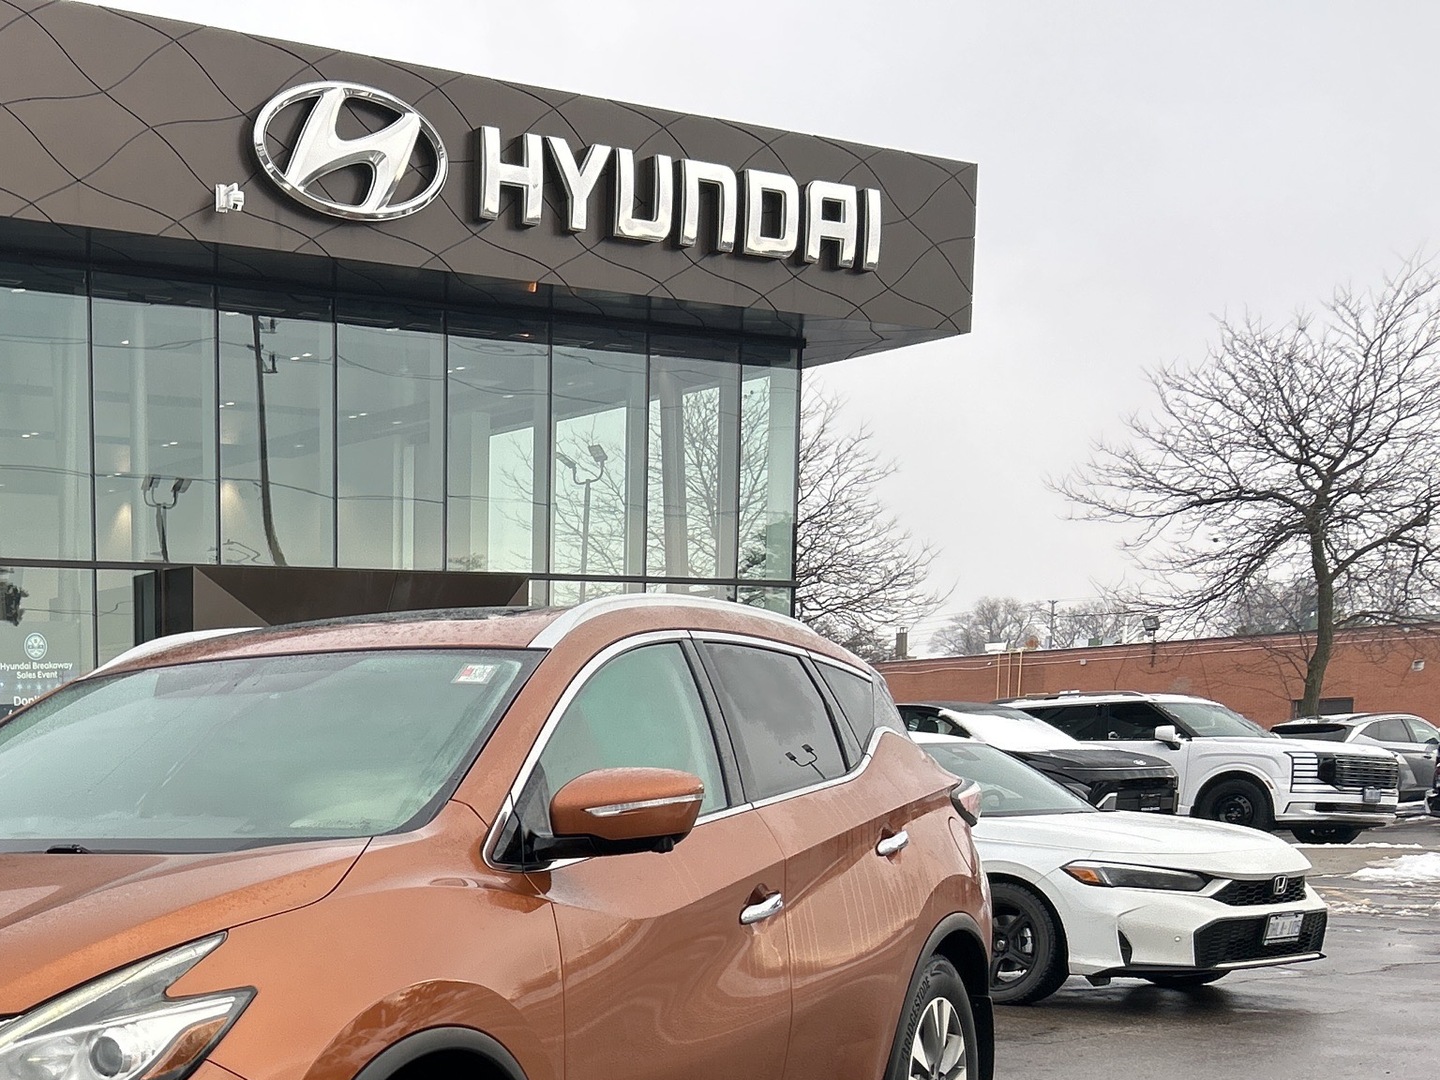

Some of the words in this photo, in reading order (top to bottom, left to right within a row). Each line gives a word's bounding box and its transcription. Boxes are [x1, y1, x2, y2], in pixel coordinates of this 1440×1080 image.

[473, 126, 881, 272] HYUNDAI
[0, 662, 32, 671] Hyundai
[32, 661, 73, 670] Breakaway
[16, 671, 36, 679] Sales
[37, 671, 58, 679] Event
[13, 695, 40, 707] Don'
